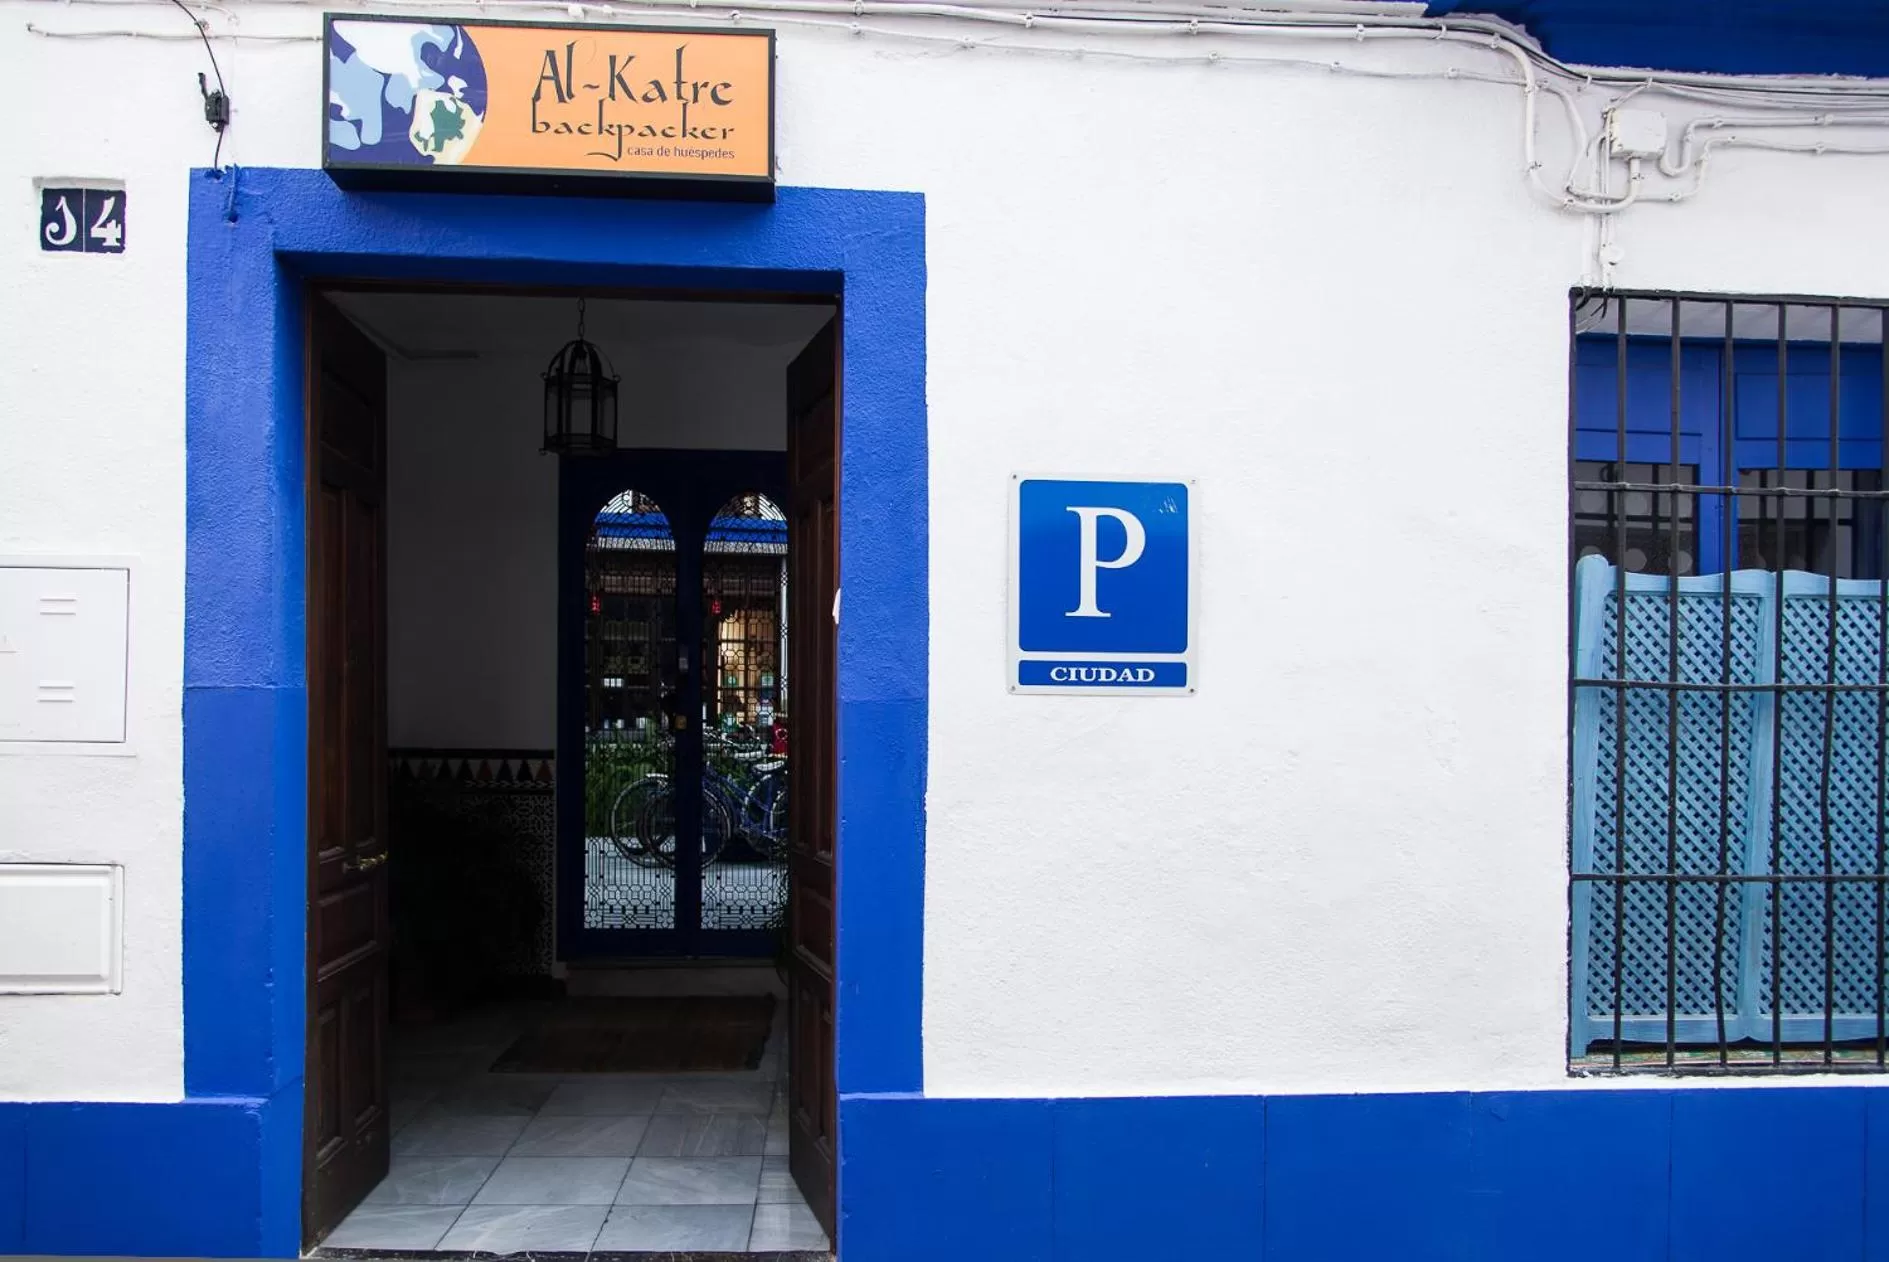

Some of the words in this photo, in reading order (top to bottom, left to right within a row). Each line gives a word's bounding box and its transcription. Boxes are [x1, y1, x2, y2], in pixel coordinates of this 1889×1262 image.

[531, 99, 735, 161] backpacker
[627, 146, 653, 156] casa
[656, 146, 671, 156] de
[1065, 506, 1146, 617] P
[1049, 667, 1156, 682] CIUDAD
